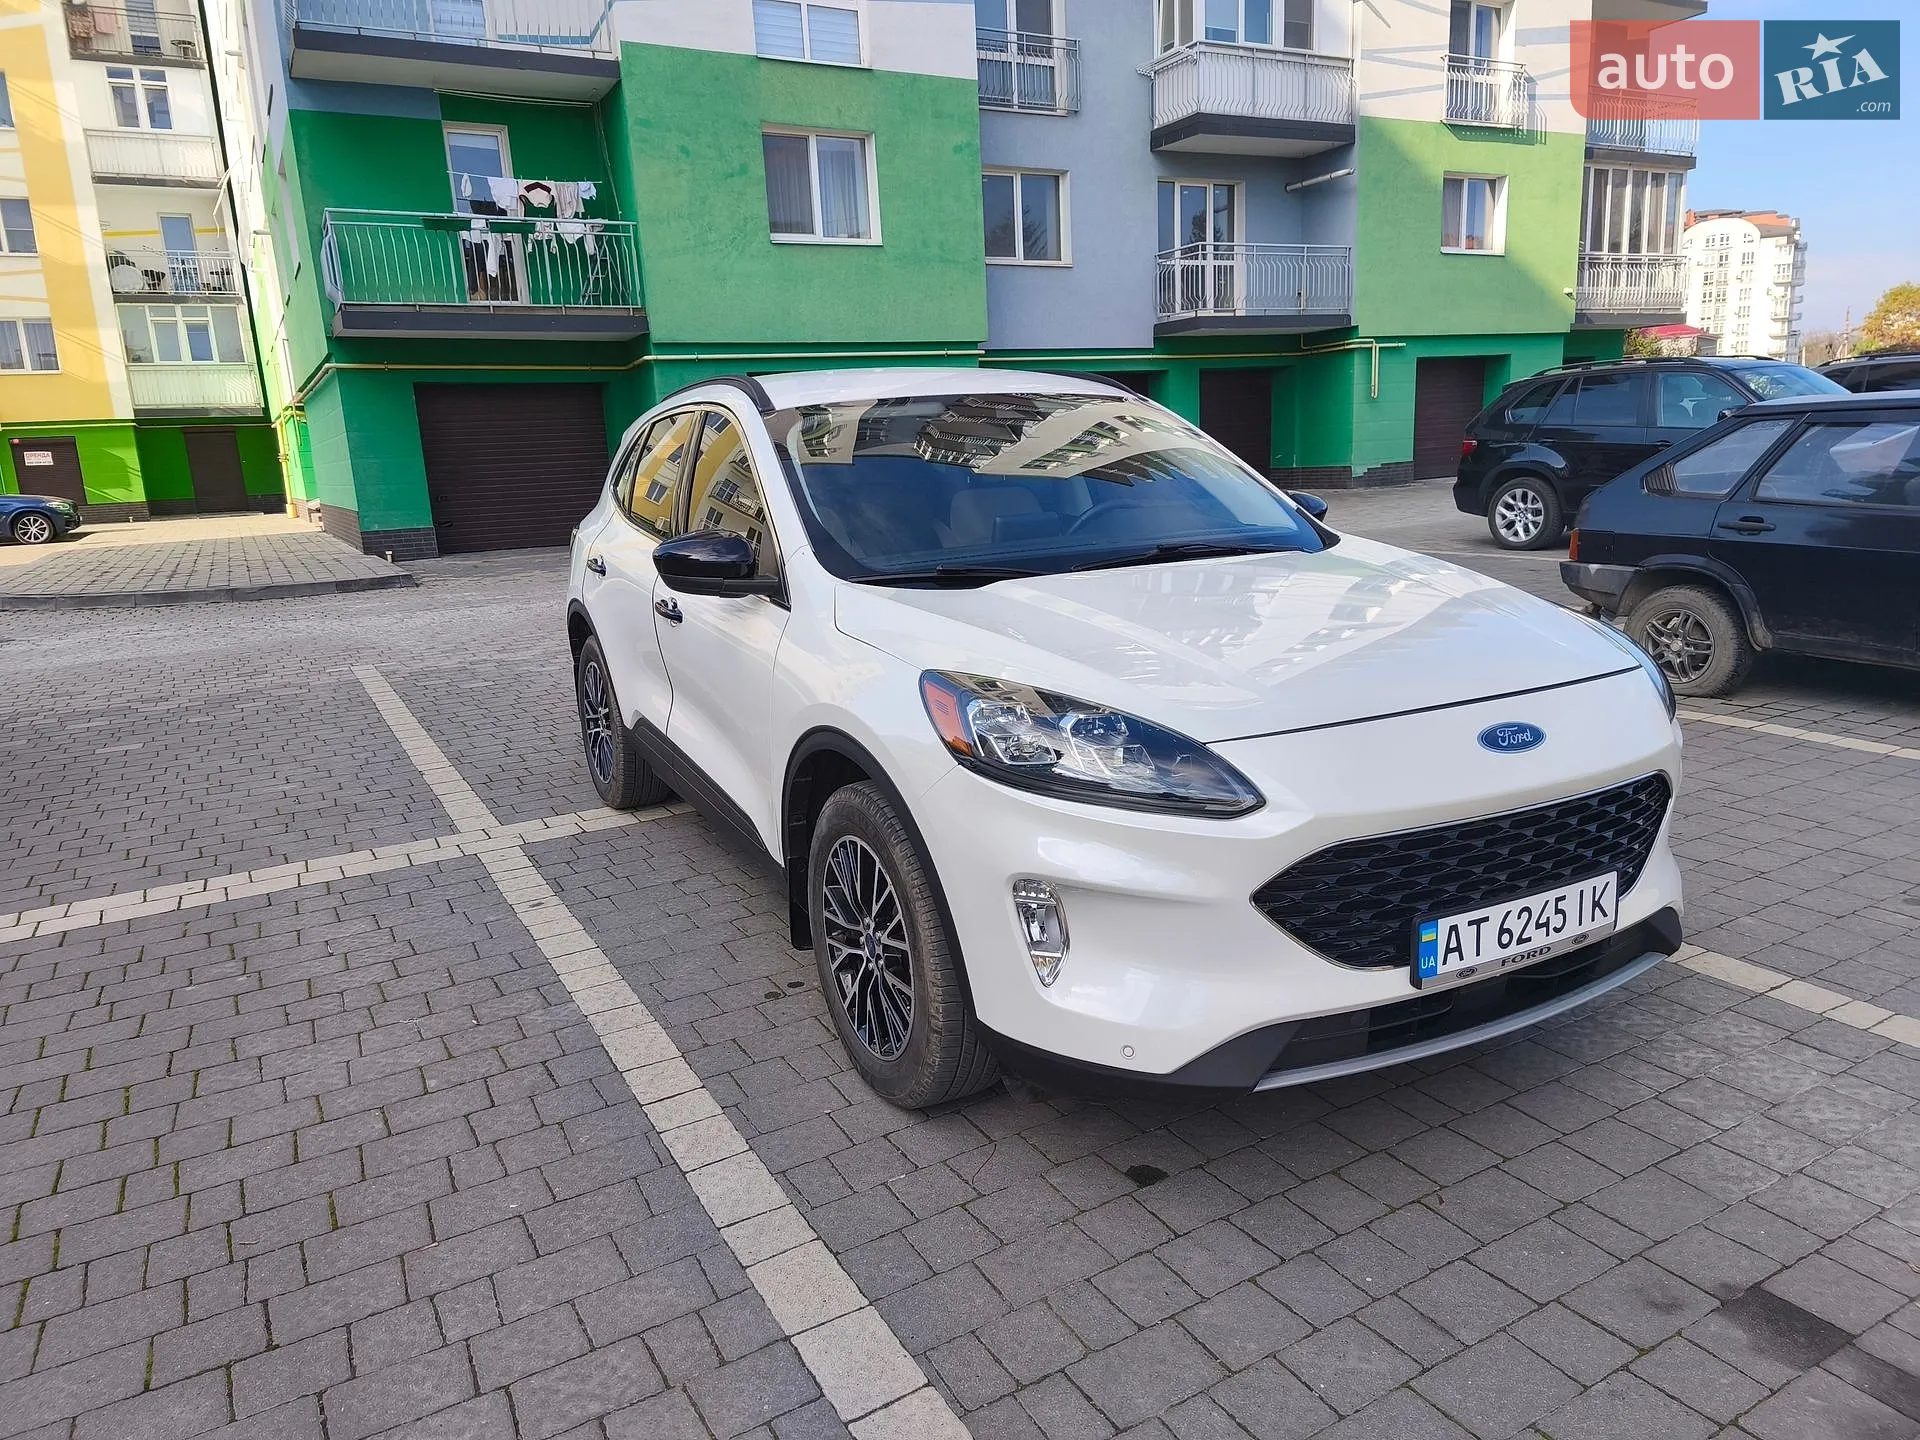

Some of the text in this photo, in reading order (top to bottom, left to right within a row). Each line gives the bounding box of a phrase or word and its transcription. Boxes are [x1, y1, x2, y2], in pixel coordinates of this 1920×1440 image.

[1497, 727, 1533, 746] Ford
[1442, 881, 1610, 966] AT 6245 IK
[1421, 956, 1436, 969] UA
[1501, 946, 1551, 967] FORD
